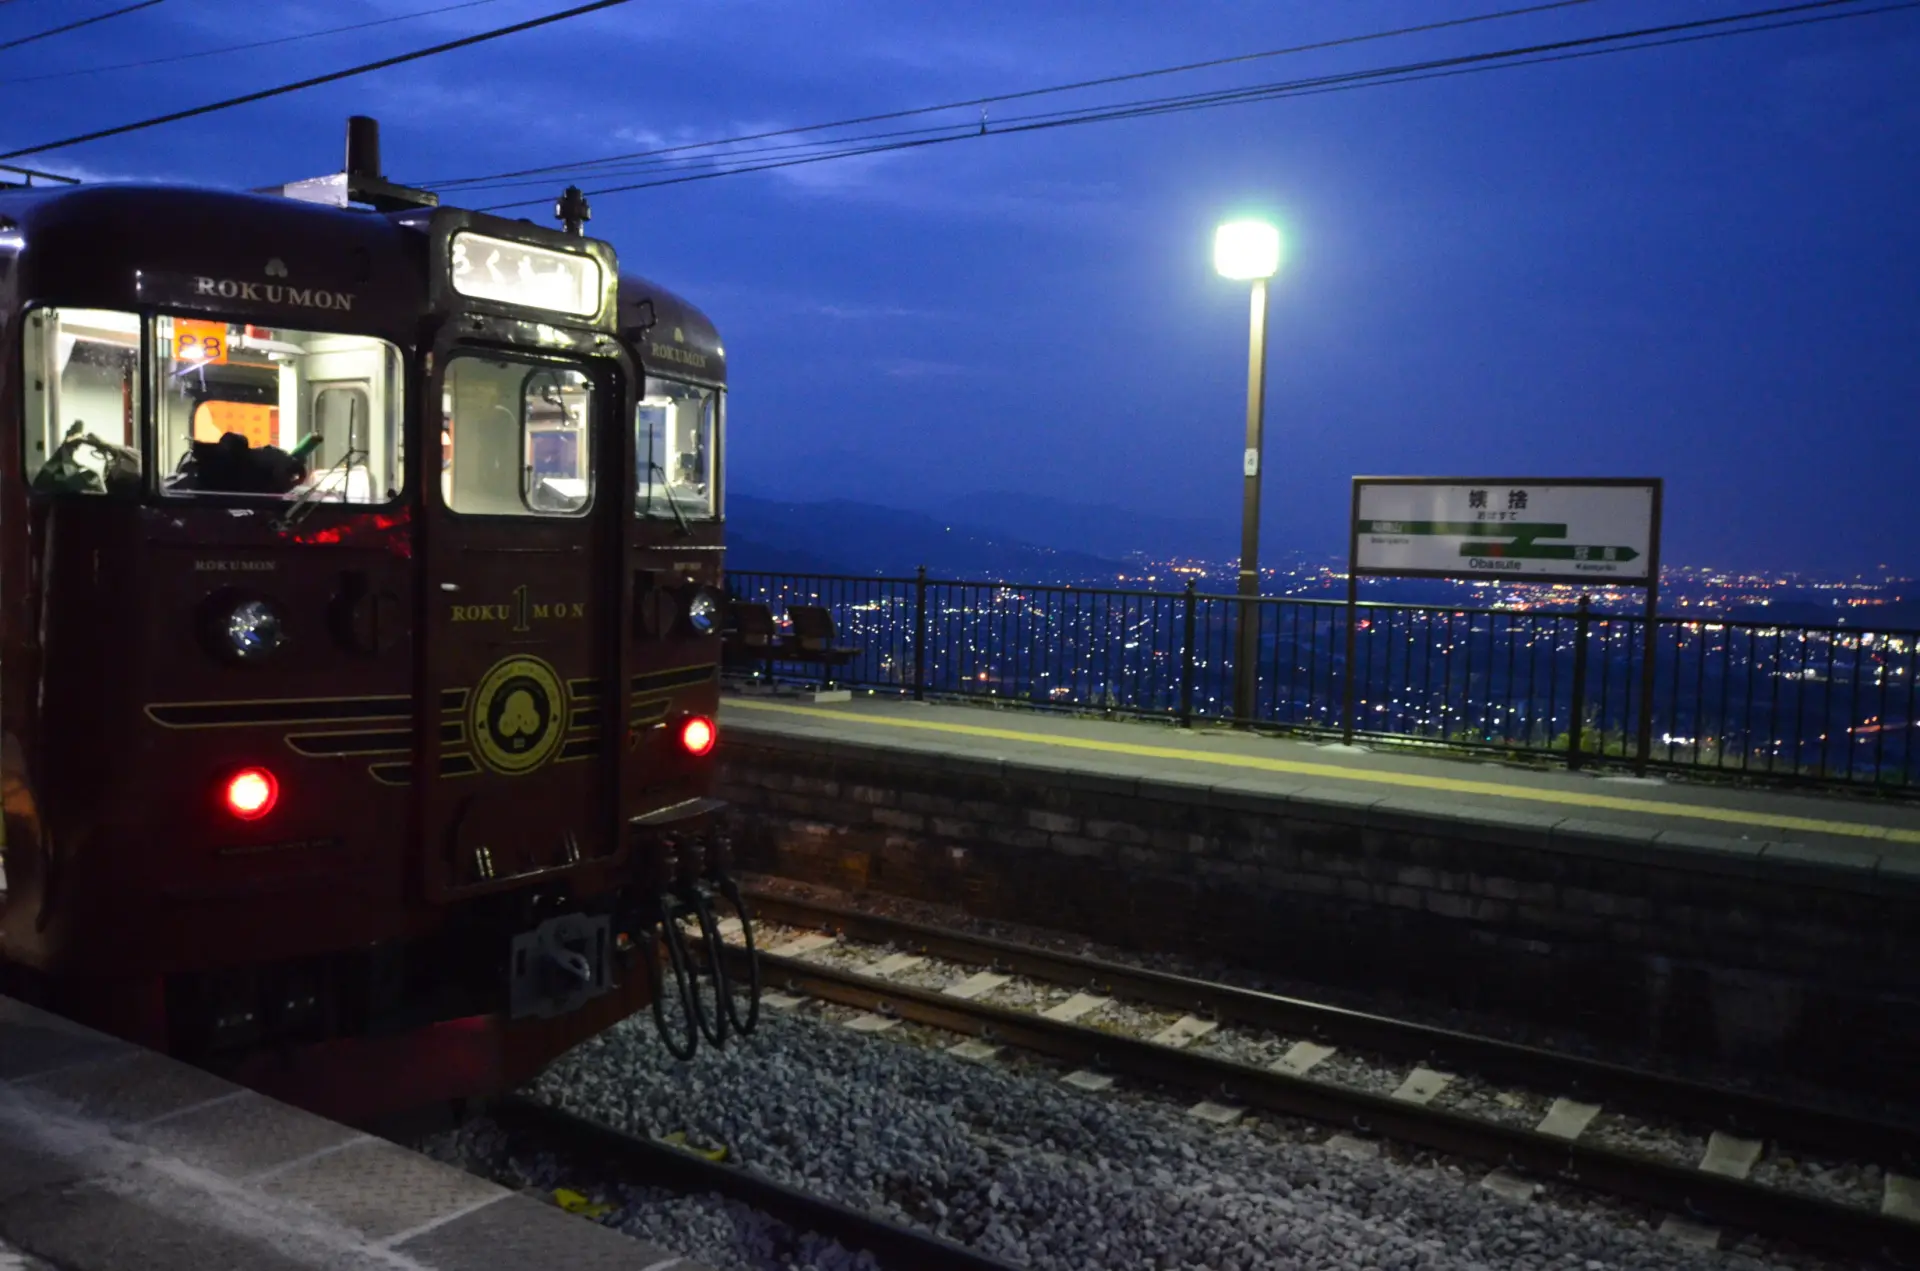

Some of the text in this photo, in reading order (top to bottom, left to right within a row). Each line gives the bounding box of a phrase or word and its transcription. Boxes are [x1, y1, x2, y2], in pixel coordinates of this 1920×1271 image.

[195, 276, 354, 311] ROKUMON
[651, 343, 707, 370] ROKUMON
[195, 560, 276, 571] ROKUMON
[1469, 557, 1522, 571] Obasute
[450, 584, 585, 631] ROKU 1 MON
